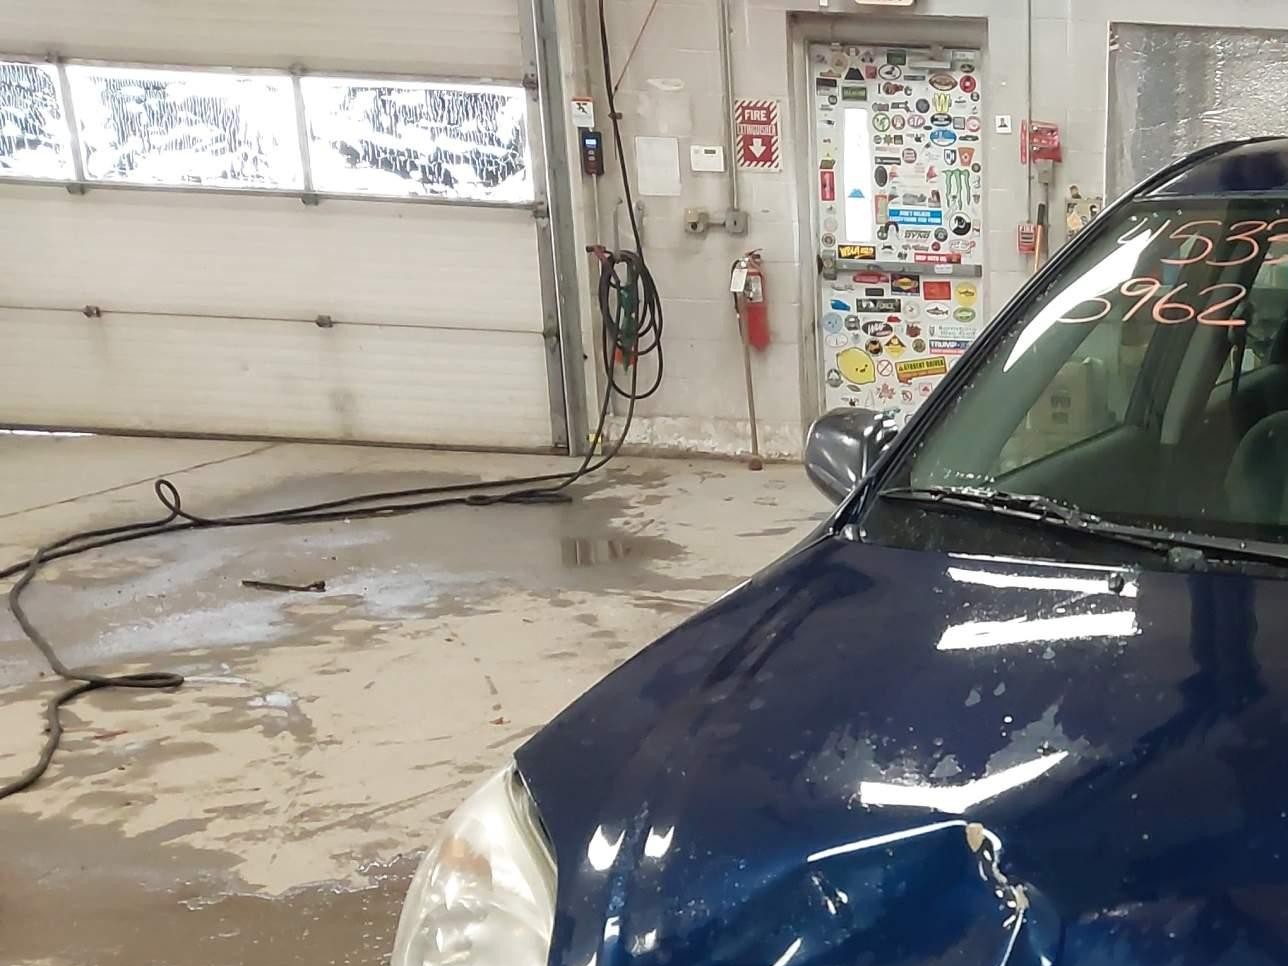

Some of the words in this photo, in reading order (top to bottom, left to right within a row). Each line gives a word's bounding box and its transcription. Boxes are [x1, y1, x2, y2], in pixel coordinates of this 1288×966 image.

[744, 109, 768, 121] FIRE
[737, 124, 776, 135] EXTINGUISHER
[903, 361, 925, 371] STUDENT
[925, 360, 944, 368] DRIVER
